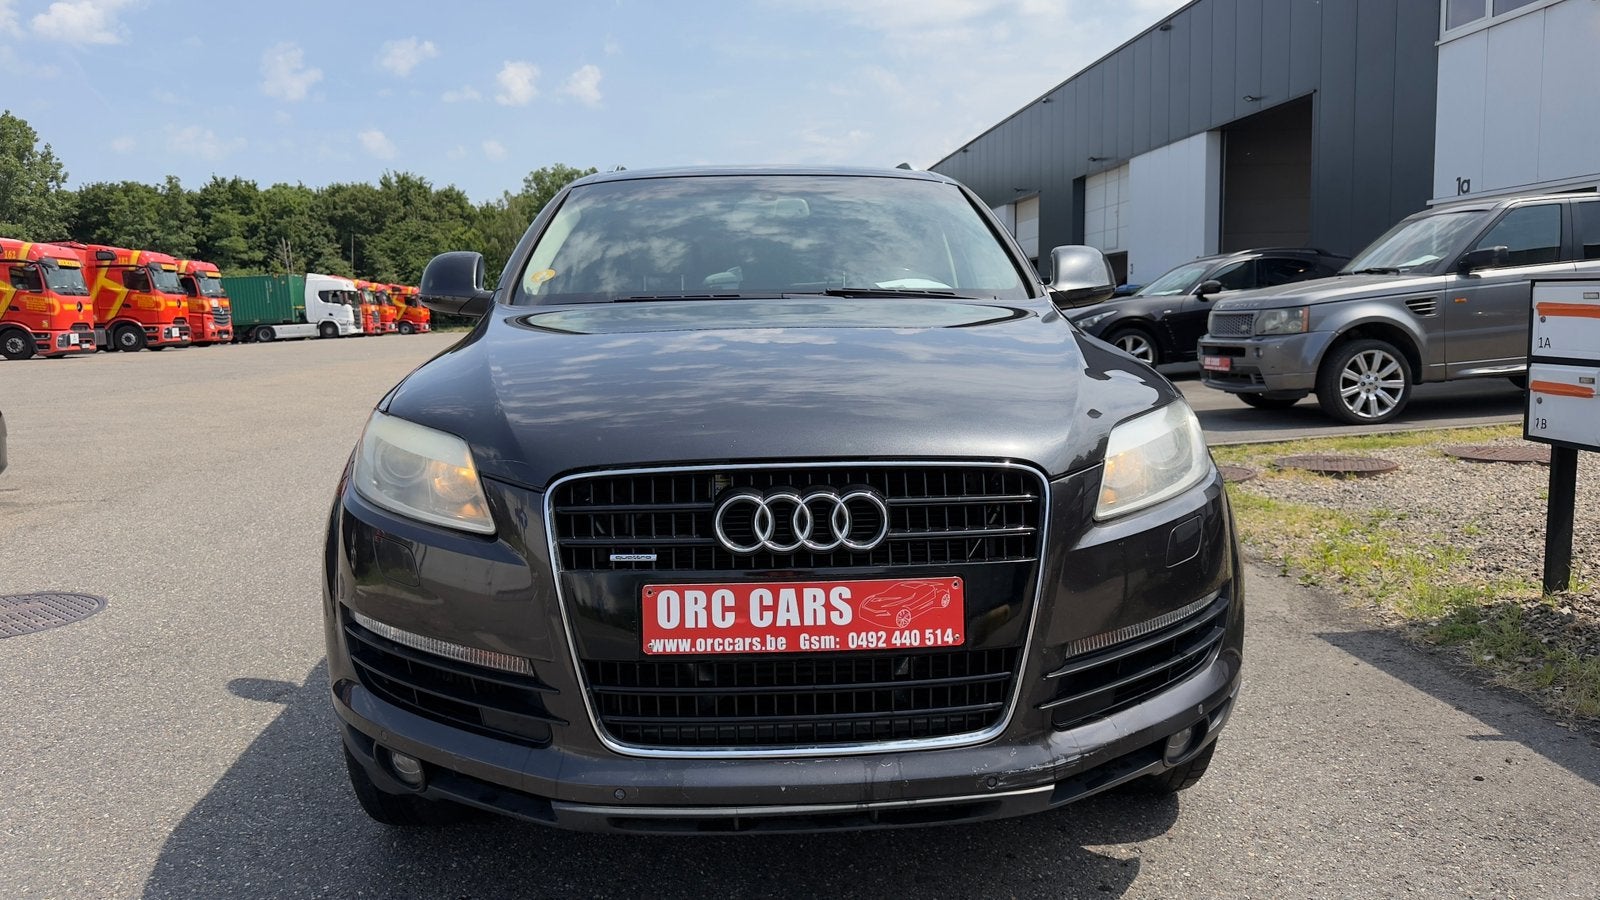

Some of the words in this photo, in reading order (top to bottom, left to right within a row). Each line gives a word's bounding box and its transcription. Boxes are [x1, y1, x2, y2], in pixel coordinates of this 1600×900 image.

[1456, 176, 1471, 196] 1a
[1538, 336, 1551, 349] 1A
[656, 589, 736, 630] ORC
[749, 586, 853, 628] CARS
[652, 634, 787, 652] www.orccars.be
[799, 633, 840, 650] Gsm:
[848, 631, 887, 649] 0492
[891, 629, 920, 647] 440
[925, 628, 954, 646] 514
